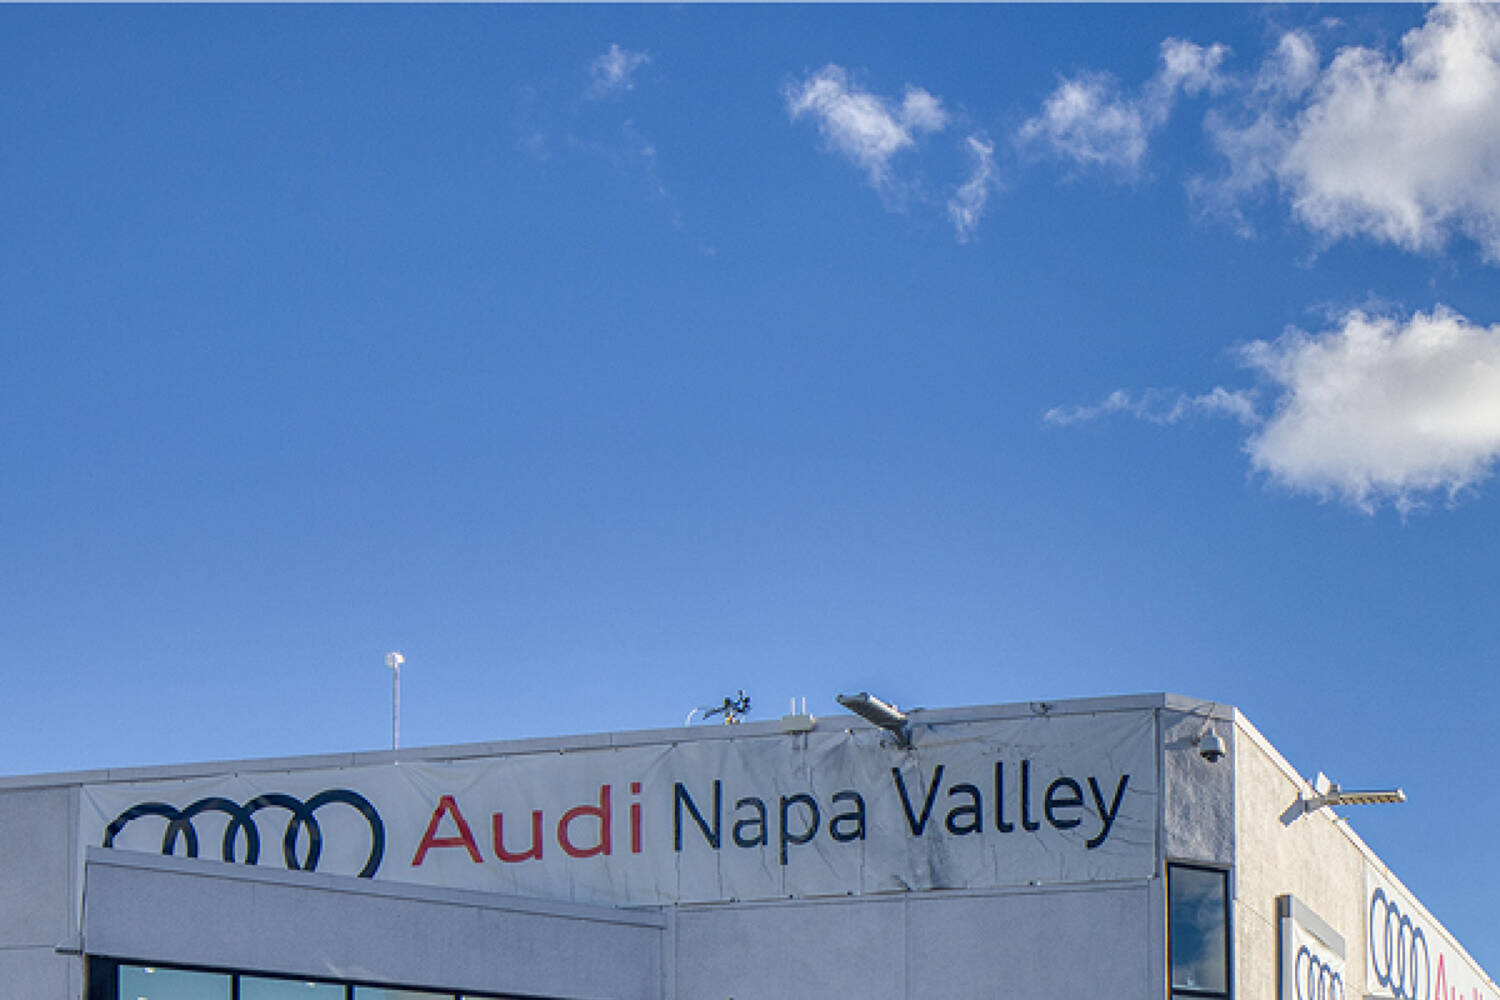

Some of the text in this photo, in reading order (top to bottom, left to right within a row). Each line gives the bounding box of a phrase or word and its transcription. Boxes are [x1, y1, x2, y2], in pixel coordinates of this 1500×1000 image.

[410, 759, 1131, 866] Audi Napa Valley
